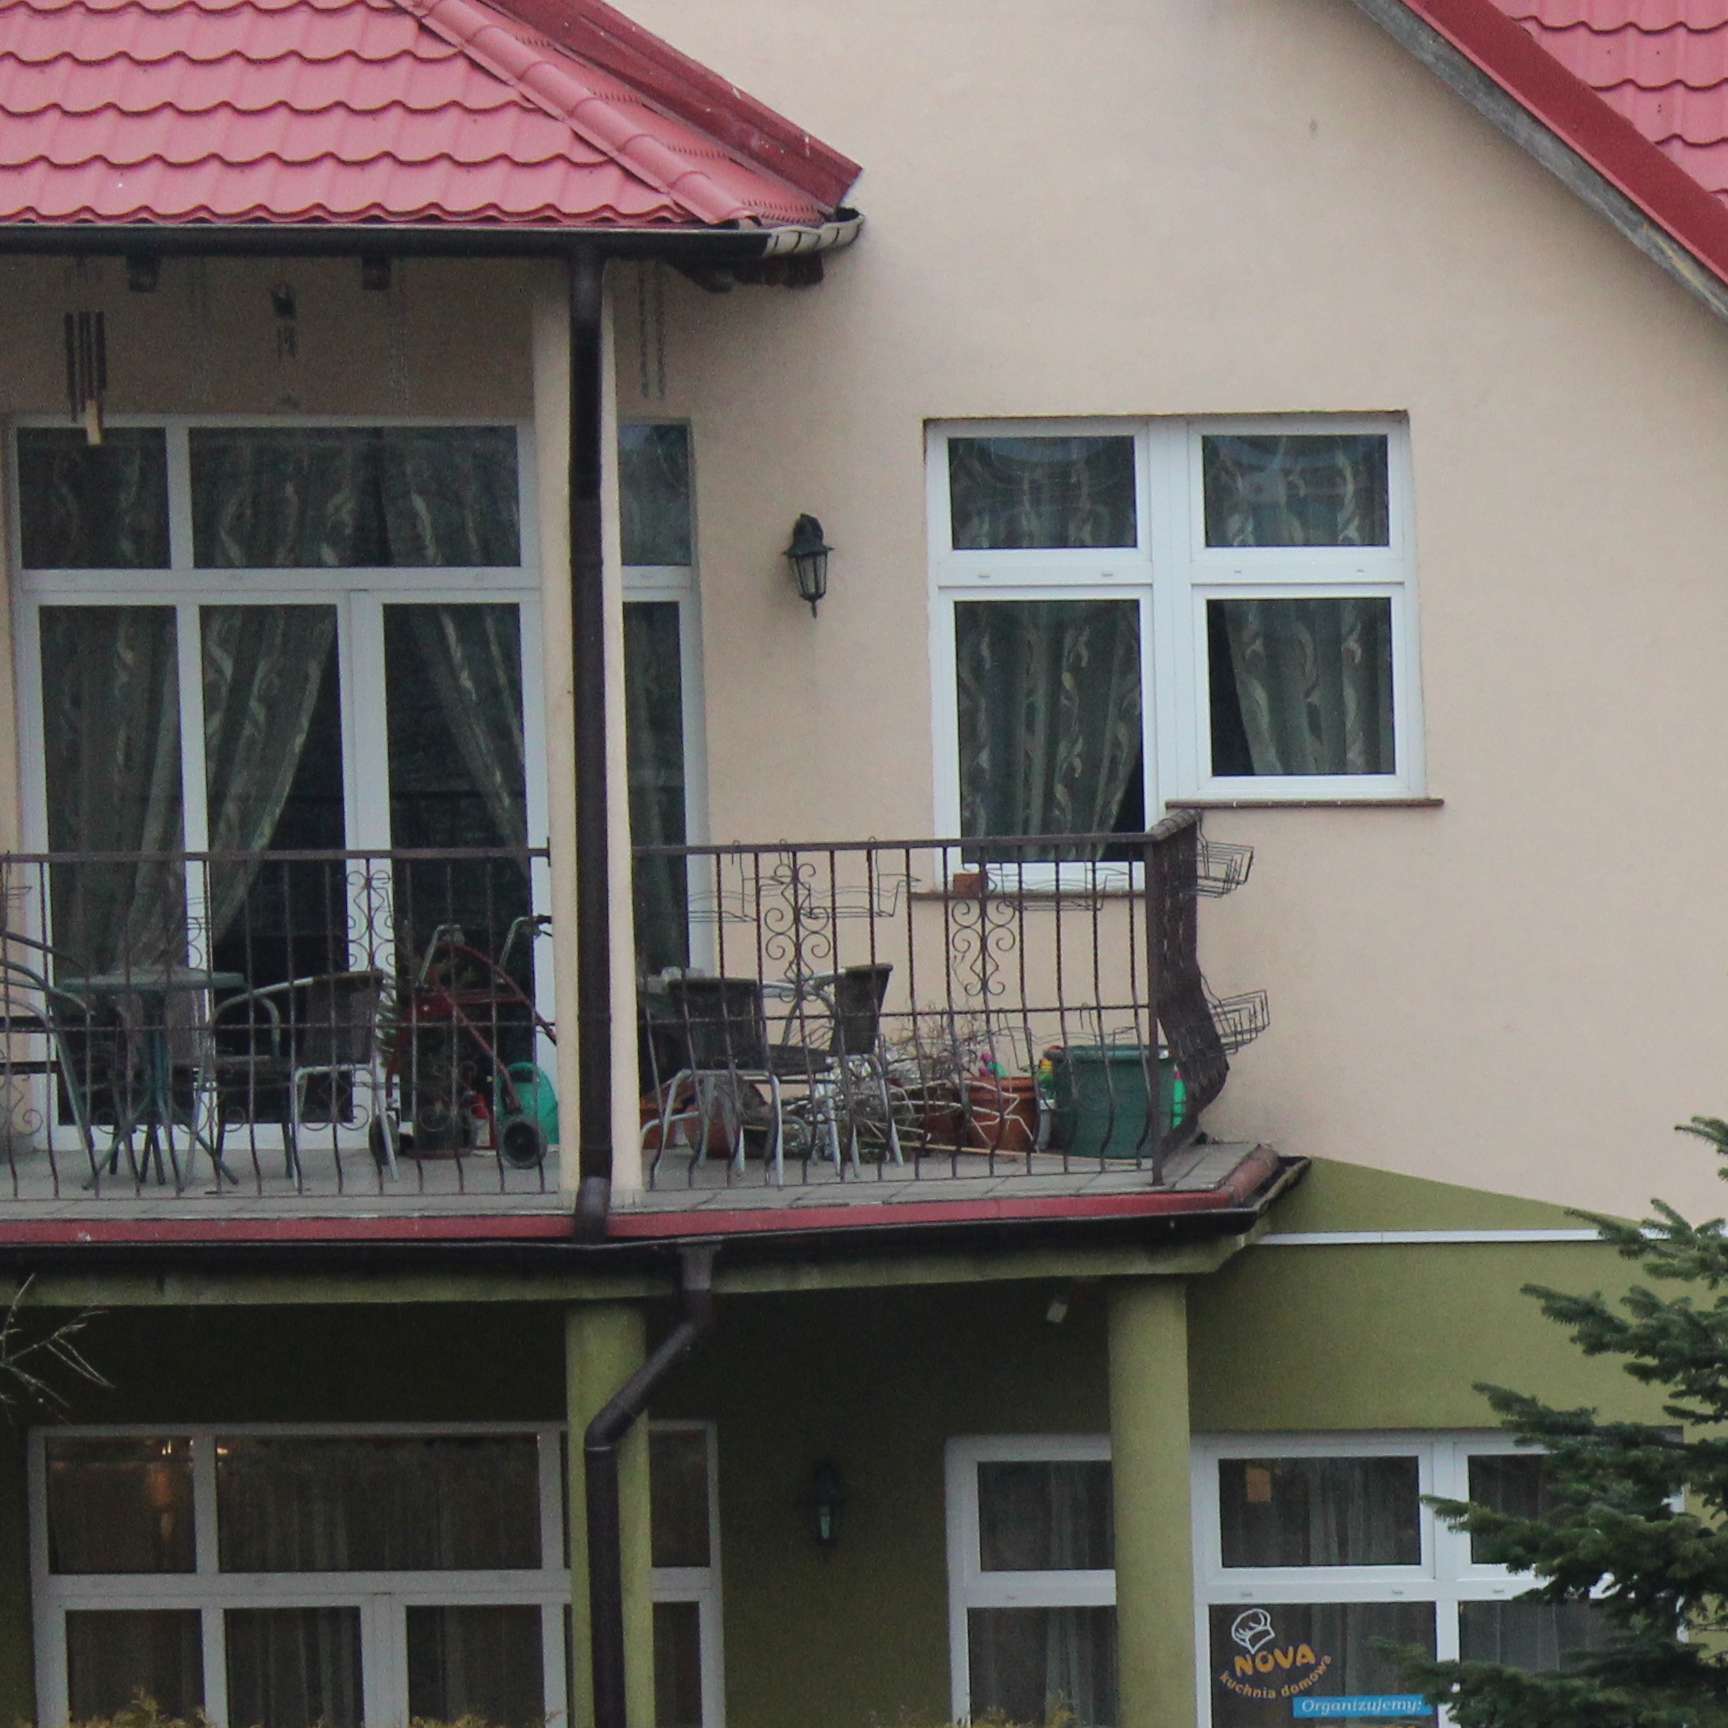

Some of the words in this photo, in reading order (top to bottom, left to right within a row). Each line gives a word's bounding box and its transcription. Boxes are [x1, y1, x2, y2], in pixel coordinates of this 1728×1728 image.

[1219, 1670, 1276, 1699] kuchnia
[1281, 1654, 1332, 1699] domowa
[1234, 1643, 1316, 1678] NOVA
